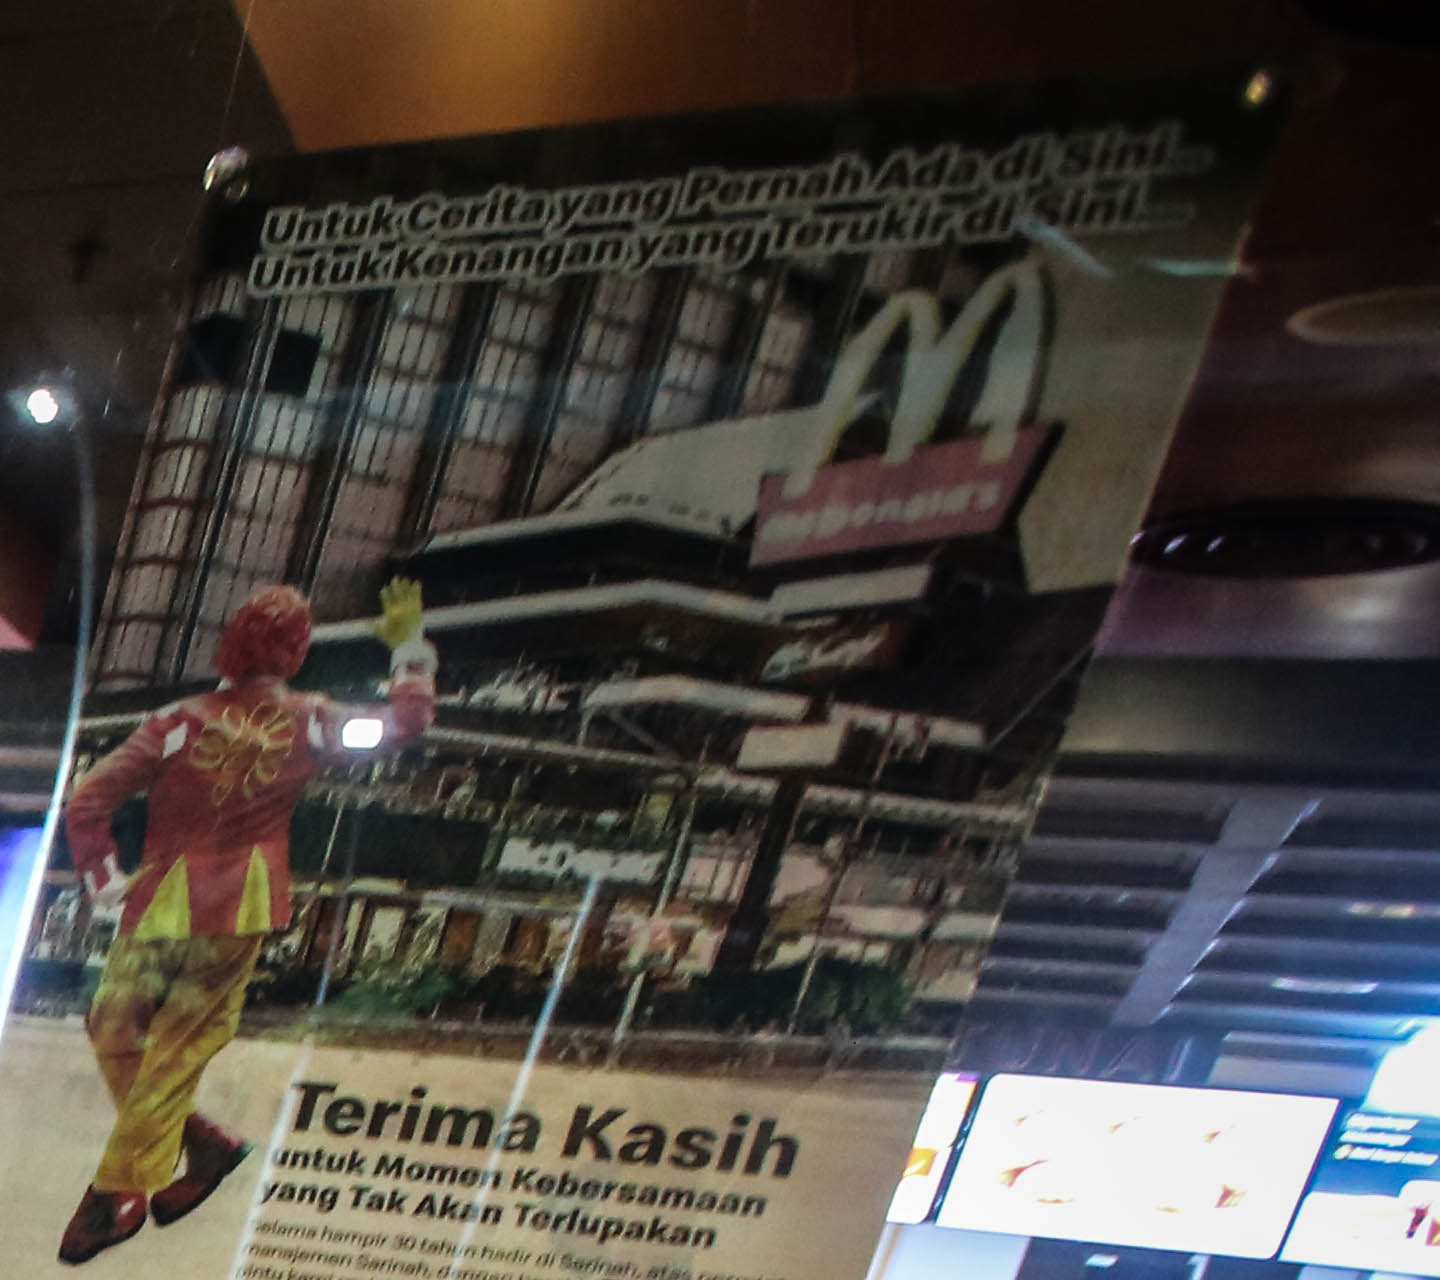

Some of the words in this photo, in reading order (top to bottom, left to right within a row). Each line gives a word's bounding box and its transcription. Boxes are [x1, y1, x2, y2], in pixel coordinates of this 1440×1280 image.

[265, 202, 395, 247] Untuk
[405, 187, 546, 231] Cerita
[553, 180, 674, 233] yang
[682, 155, 865, 210] Pernah
[873, 145, 978, 191] Ada
[992, 137, 1046, 182] di
[250, 249, 380, 291] Untuk
[392, 235, 622, 281] Kenangan
[626, 220, 755, 275] yang
[766, 198, 952, 249] Terukir
[963, 192, 1015, 237] di
[291, 1080, 542, 1155] Terima
[560, 1103, 801, 1178] Kasih
[260, 1179, 338, 1213] yang
[349, 1184, 406, 1215] Tak
[413, 1192, 502, 1226] Akan
[514, 1203, 717, 1250] Terlupakan
[274, 1147, 365, 1178] untuk
[373, 1153, 502, 1191] Momen
[511, 1167, 767, 1218] Kebersamaan
[320, 1225, 386, 1249] hampir
